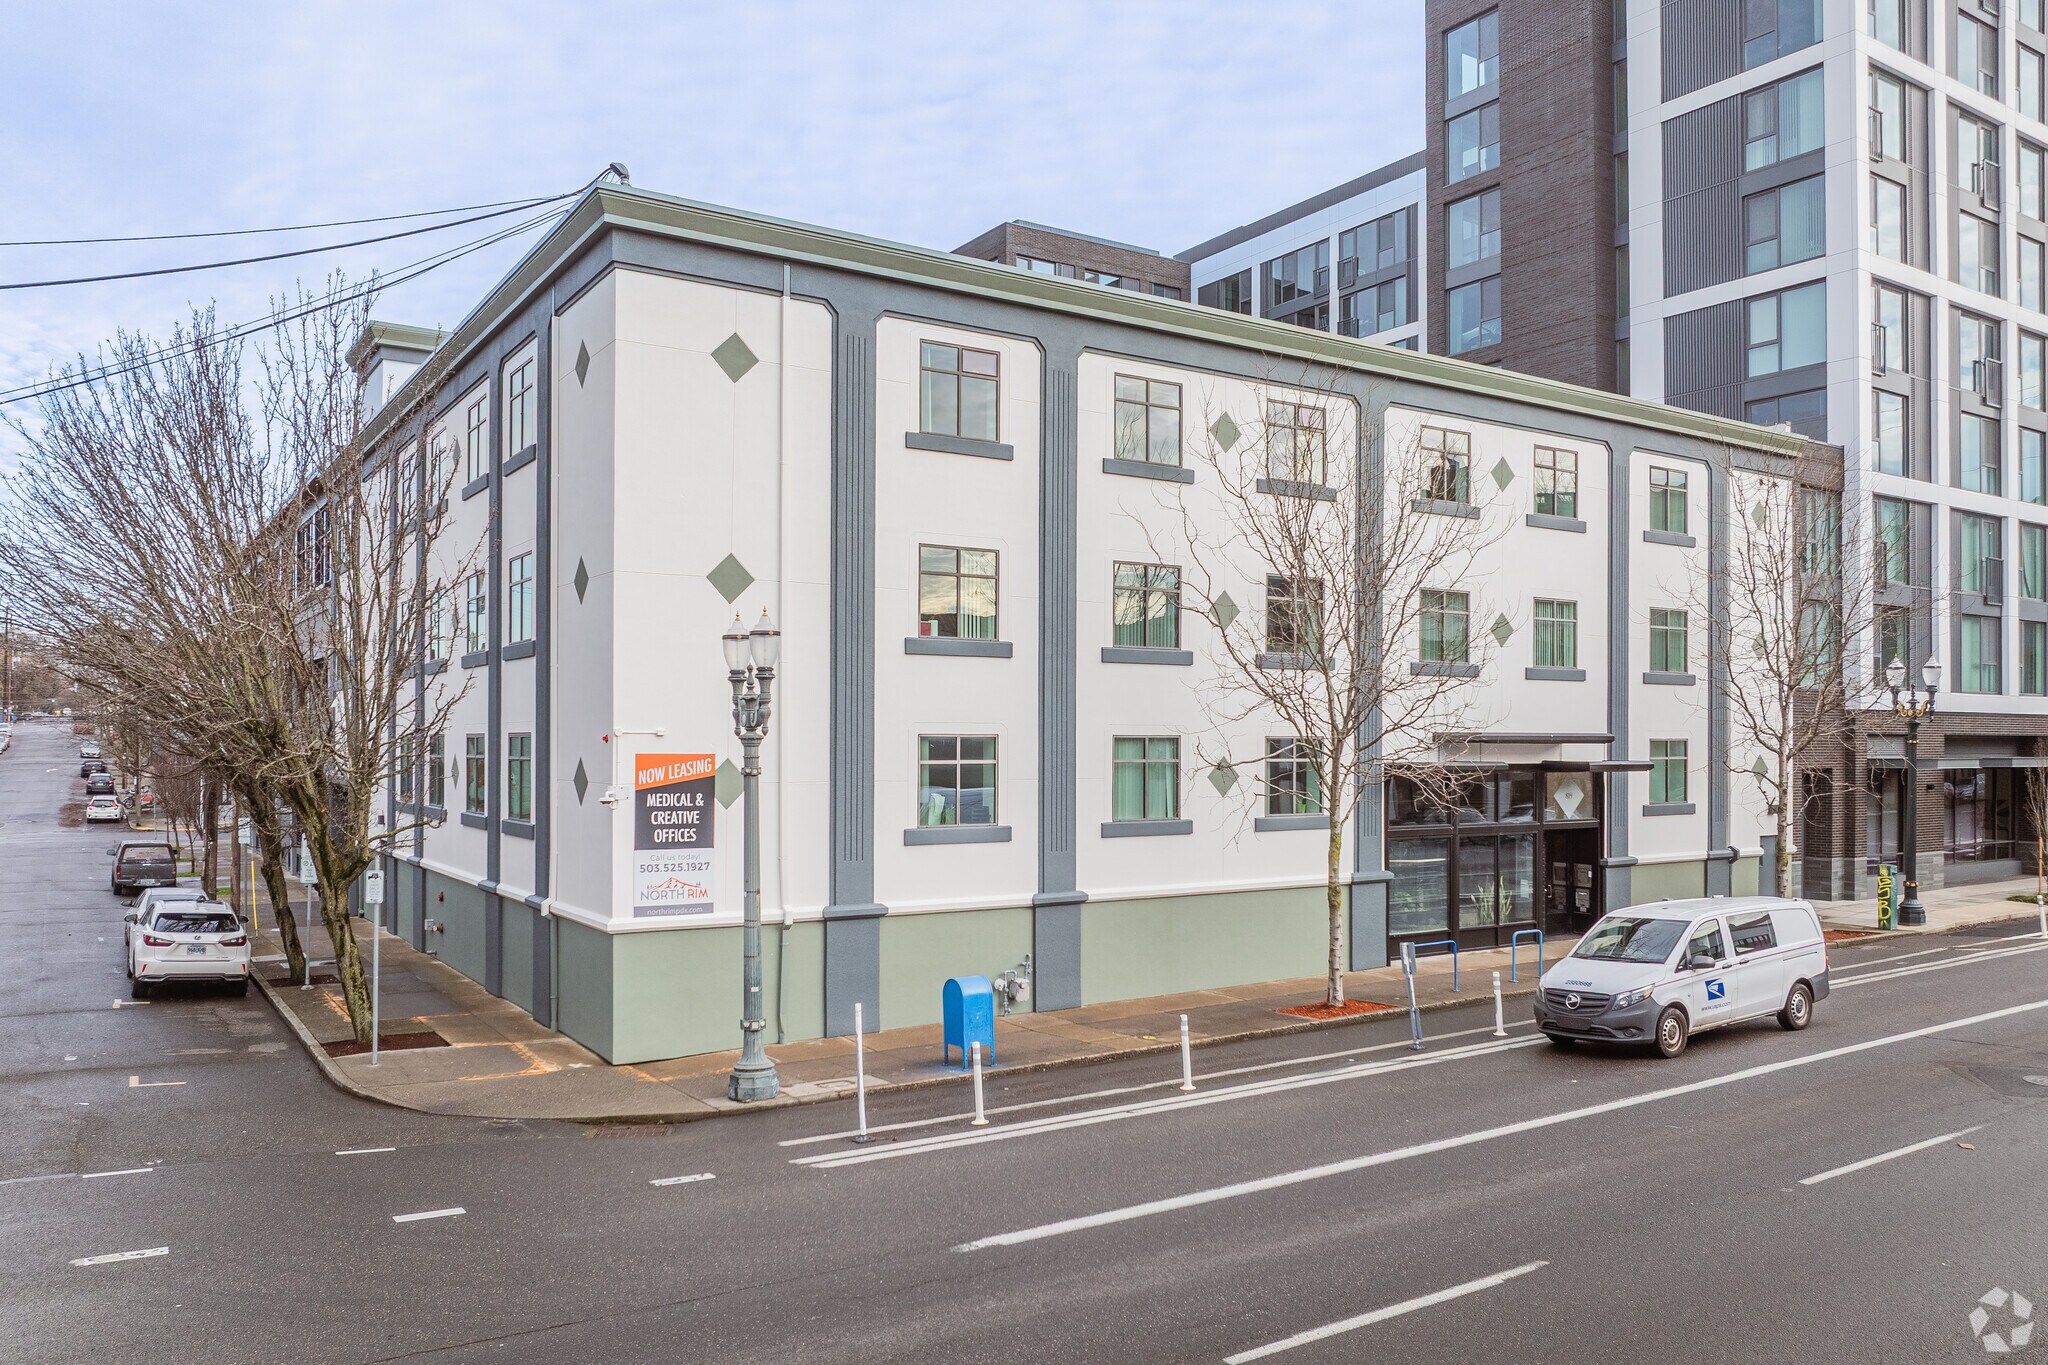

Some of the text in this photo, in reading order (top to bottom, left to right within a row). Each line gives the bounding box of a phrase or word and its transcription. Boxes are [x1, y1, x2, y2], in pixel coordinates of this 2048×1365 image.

[638, 758, 712, 785] NOW LEASING
[646, 793, 704, 807] MEDICAL &
[651, 811, 700, 825] CREATIVE
[654, 828, 697, 843] OFFICES
[650, 854, 665, 862] Call
[678, 854, 701, 862] today!
[639, 862, 710, 873] 503.525.1927
[640, 888, 709, 901] NORTH RIM
